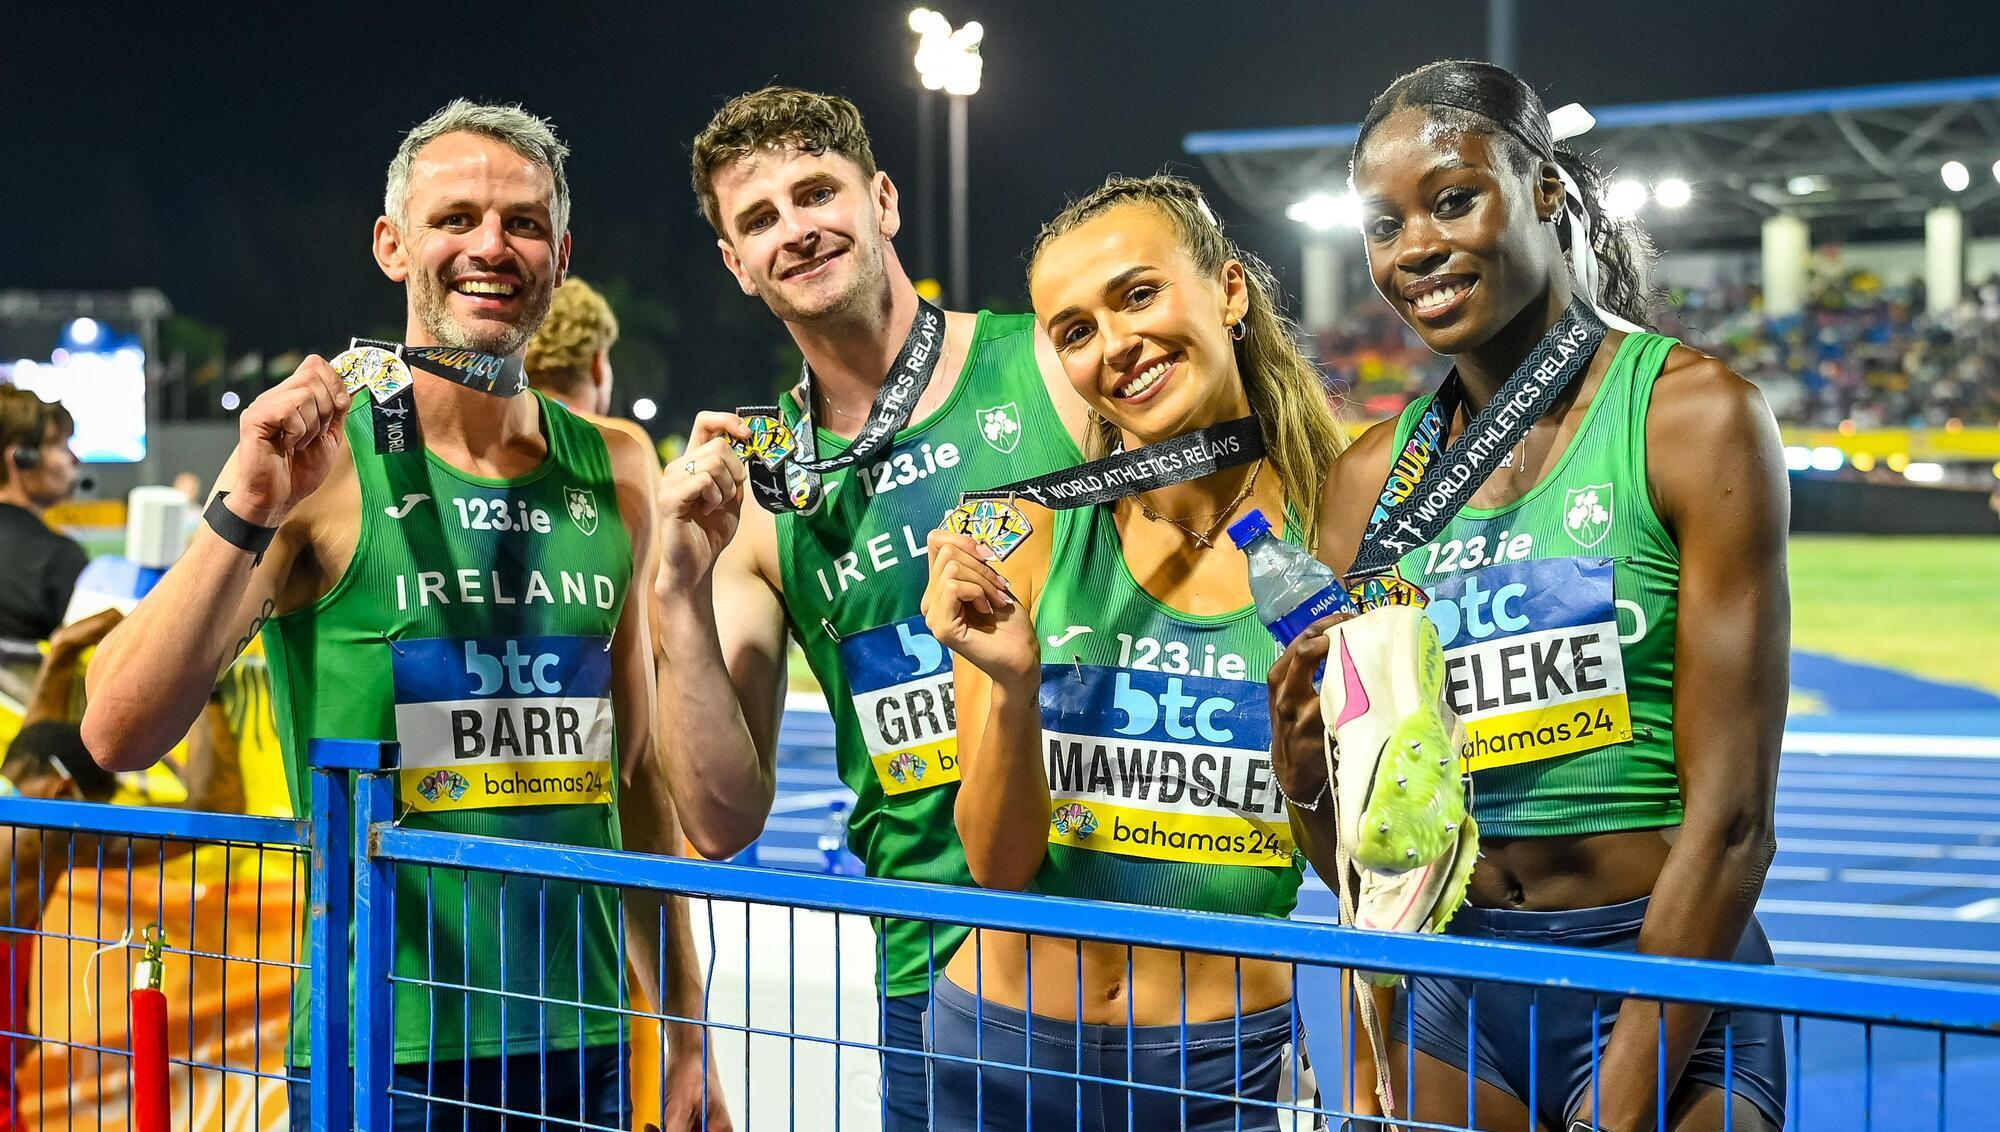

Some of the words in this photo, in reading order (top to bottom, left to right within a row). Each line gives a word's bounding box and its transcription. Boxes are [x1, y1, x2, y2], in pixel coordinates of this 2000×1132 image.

[801, 456, 854, 470] ORLD
[853, 374, 914, 456] ATHLETICS
[905, 312, 938, 372] RELAYS
[1414, 463, 1471, 523] WORLD
[1464, 382, 1540, 469] ATHLETICS
[1533, 324, 1588, 386] RELAYS
[856, 441, 961, 497] 123.ie
[1046, 473, 1102, 501] WORLD
[1102, 450, 1183, 488] ATHLETICS
[1185, 436, 1240, 466] RELAYS
[453, 498, 551, 534] 123.ie
[816, 524, 931, 602] IREL
[1424, 530, 1533, 575] 123.ie
[396, 569, 615, 611] IRELAND
[1311, 593, 1337, 616] DASANI
[464, 640, 562, 695] btc
[1117, 633, 1246, 680] 123.ie
[1445, 633, 1608, 715] ELEKE
[451, 706, 584, 760] BARR
[875, 682, 957, 746] GRE
[1113, 672, 1236, 743] btc
[1462, 708, 1614, 759] ahamas24
[485, 771, 603, 795] bahamas24
[1113, 816, 1280, 855] bahamas24
